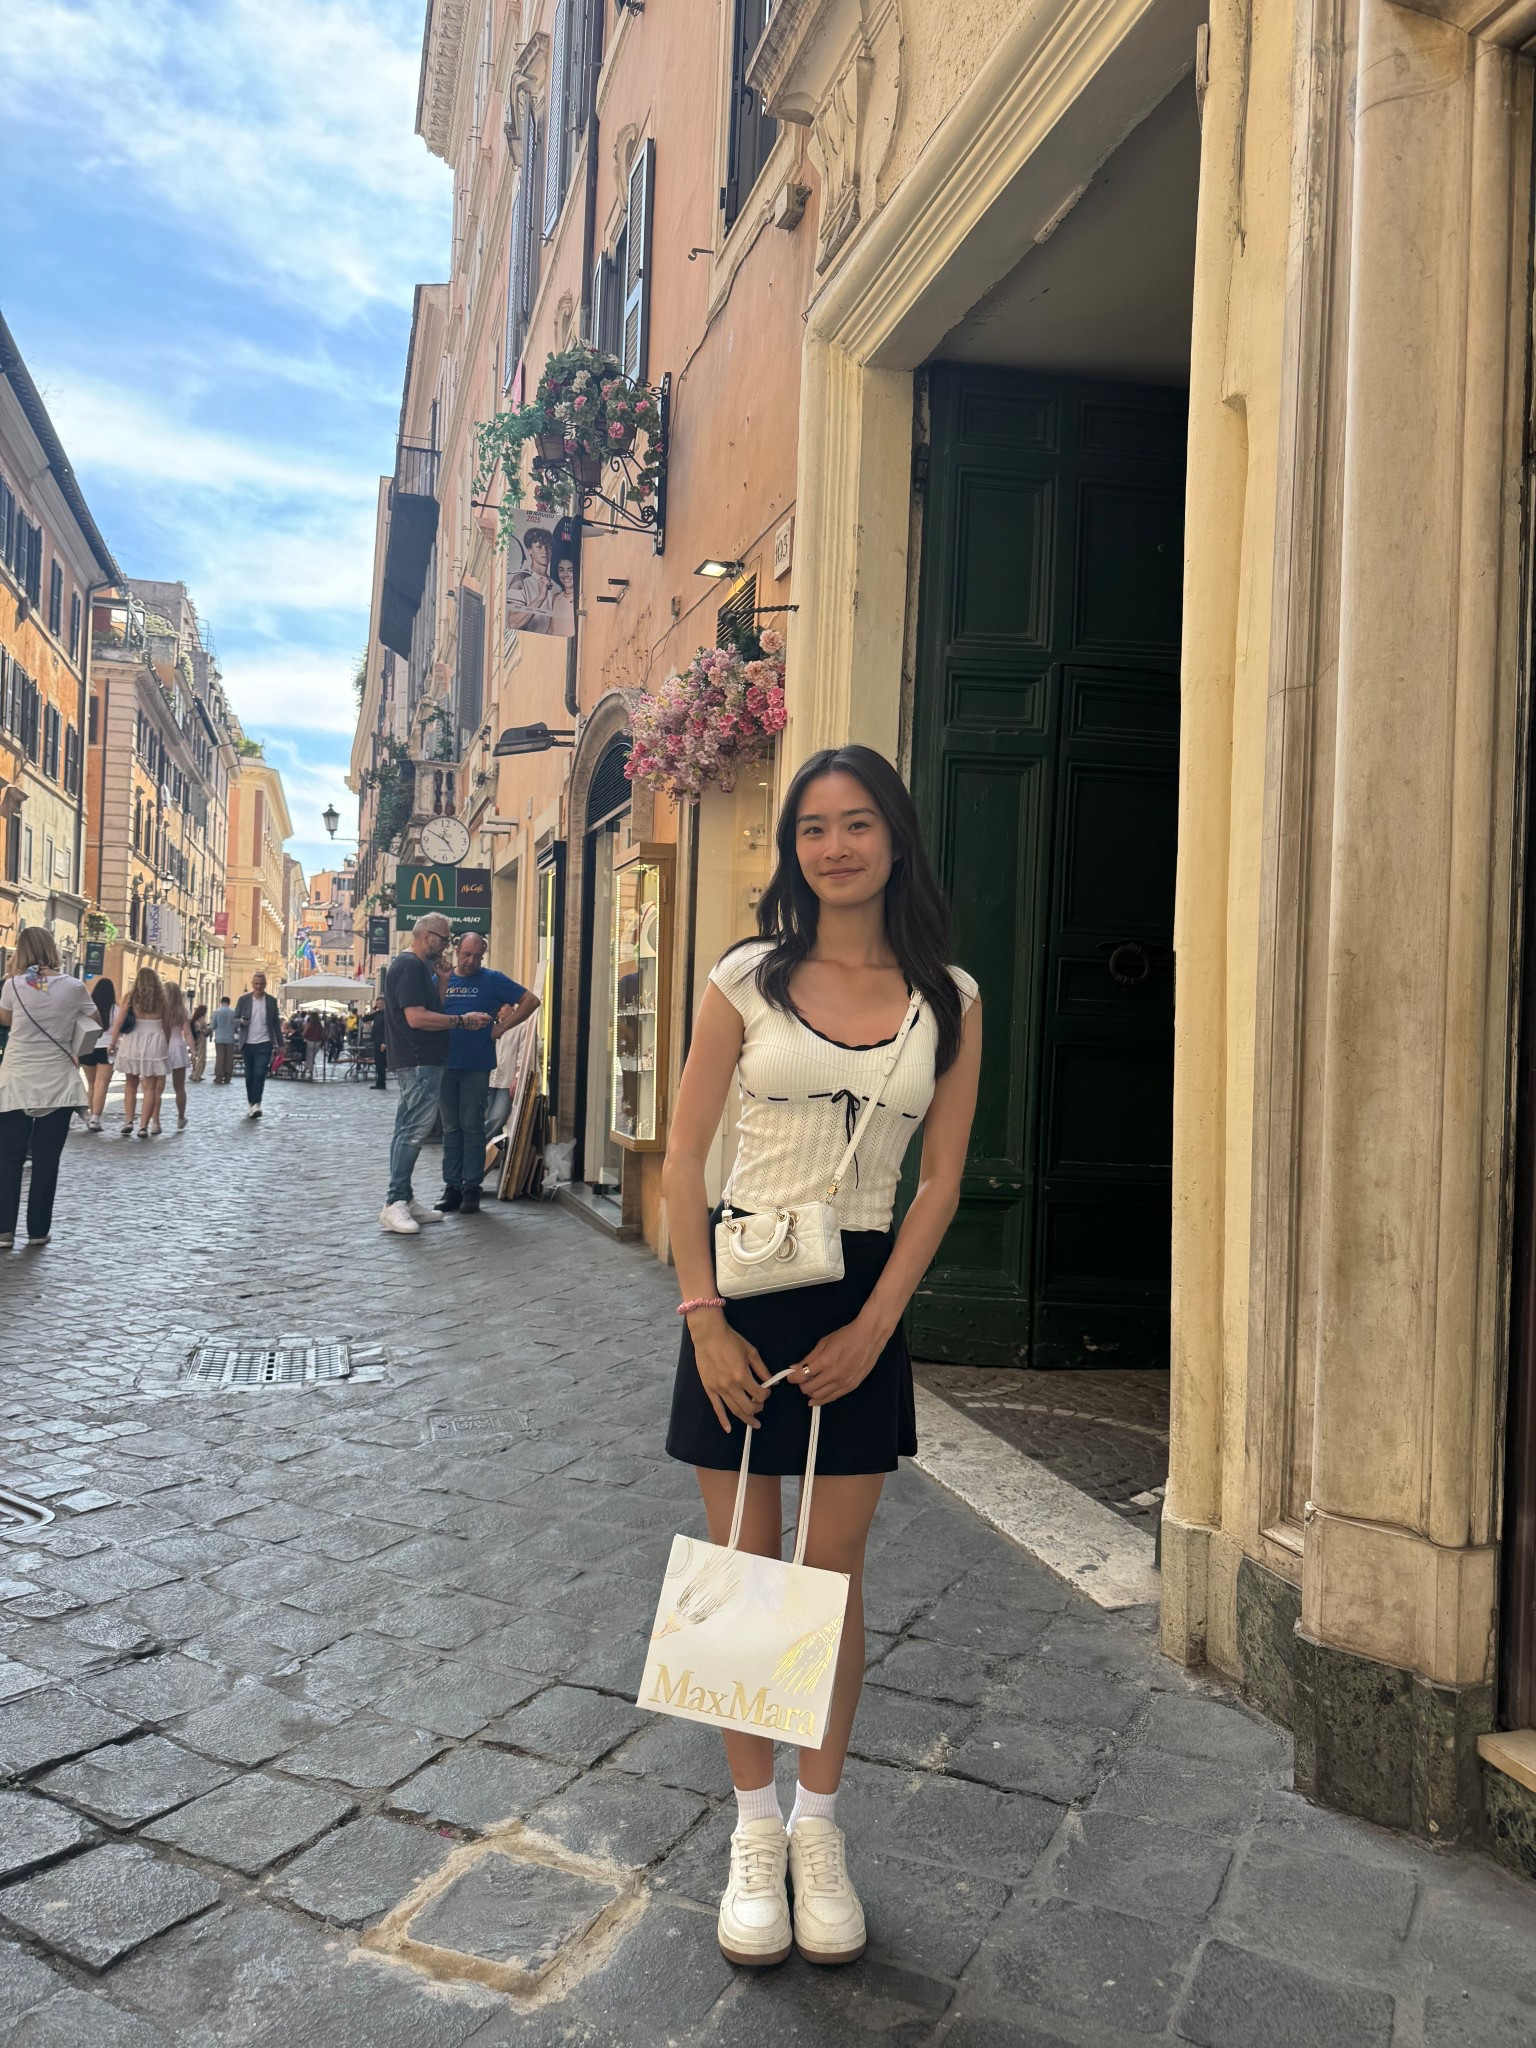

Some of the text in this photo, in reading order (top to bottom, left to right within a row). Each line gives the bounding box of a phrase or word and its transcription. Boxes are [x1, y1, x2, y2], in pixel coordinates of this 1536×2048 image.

[526, 515, 541, 524] 2025
[441, 819, 451, 828] 12
[423, 836, 429, 844] 9
[461, 837, 467, 846] 3
[442, 854, 448, 862] 6
[647, 1663, 817, 1737] MaxMara
